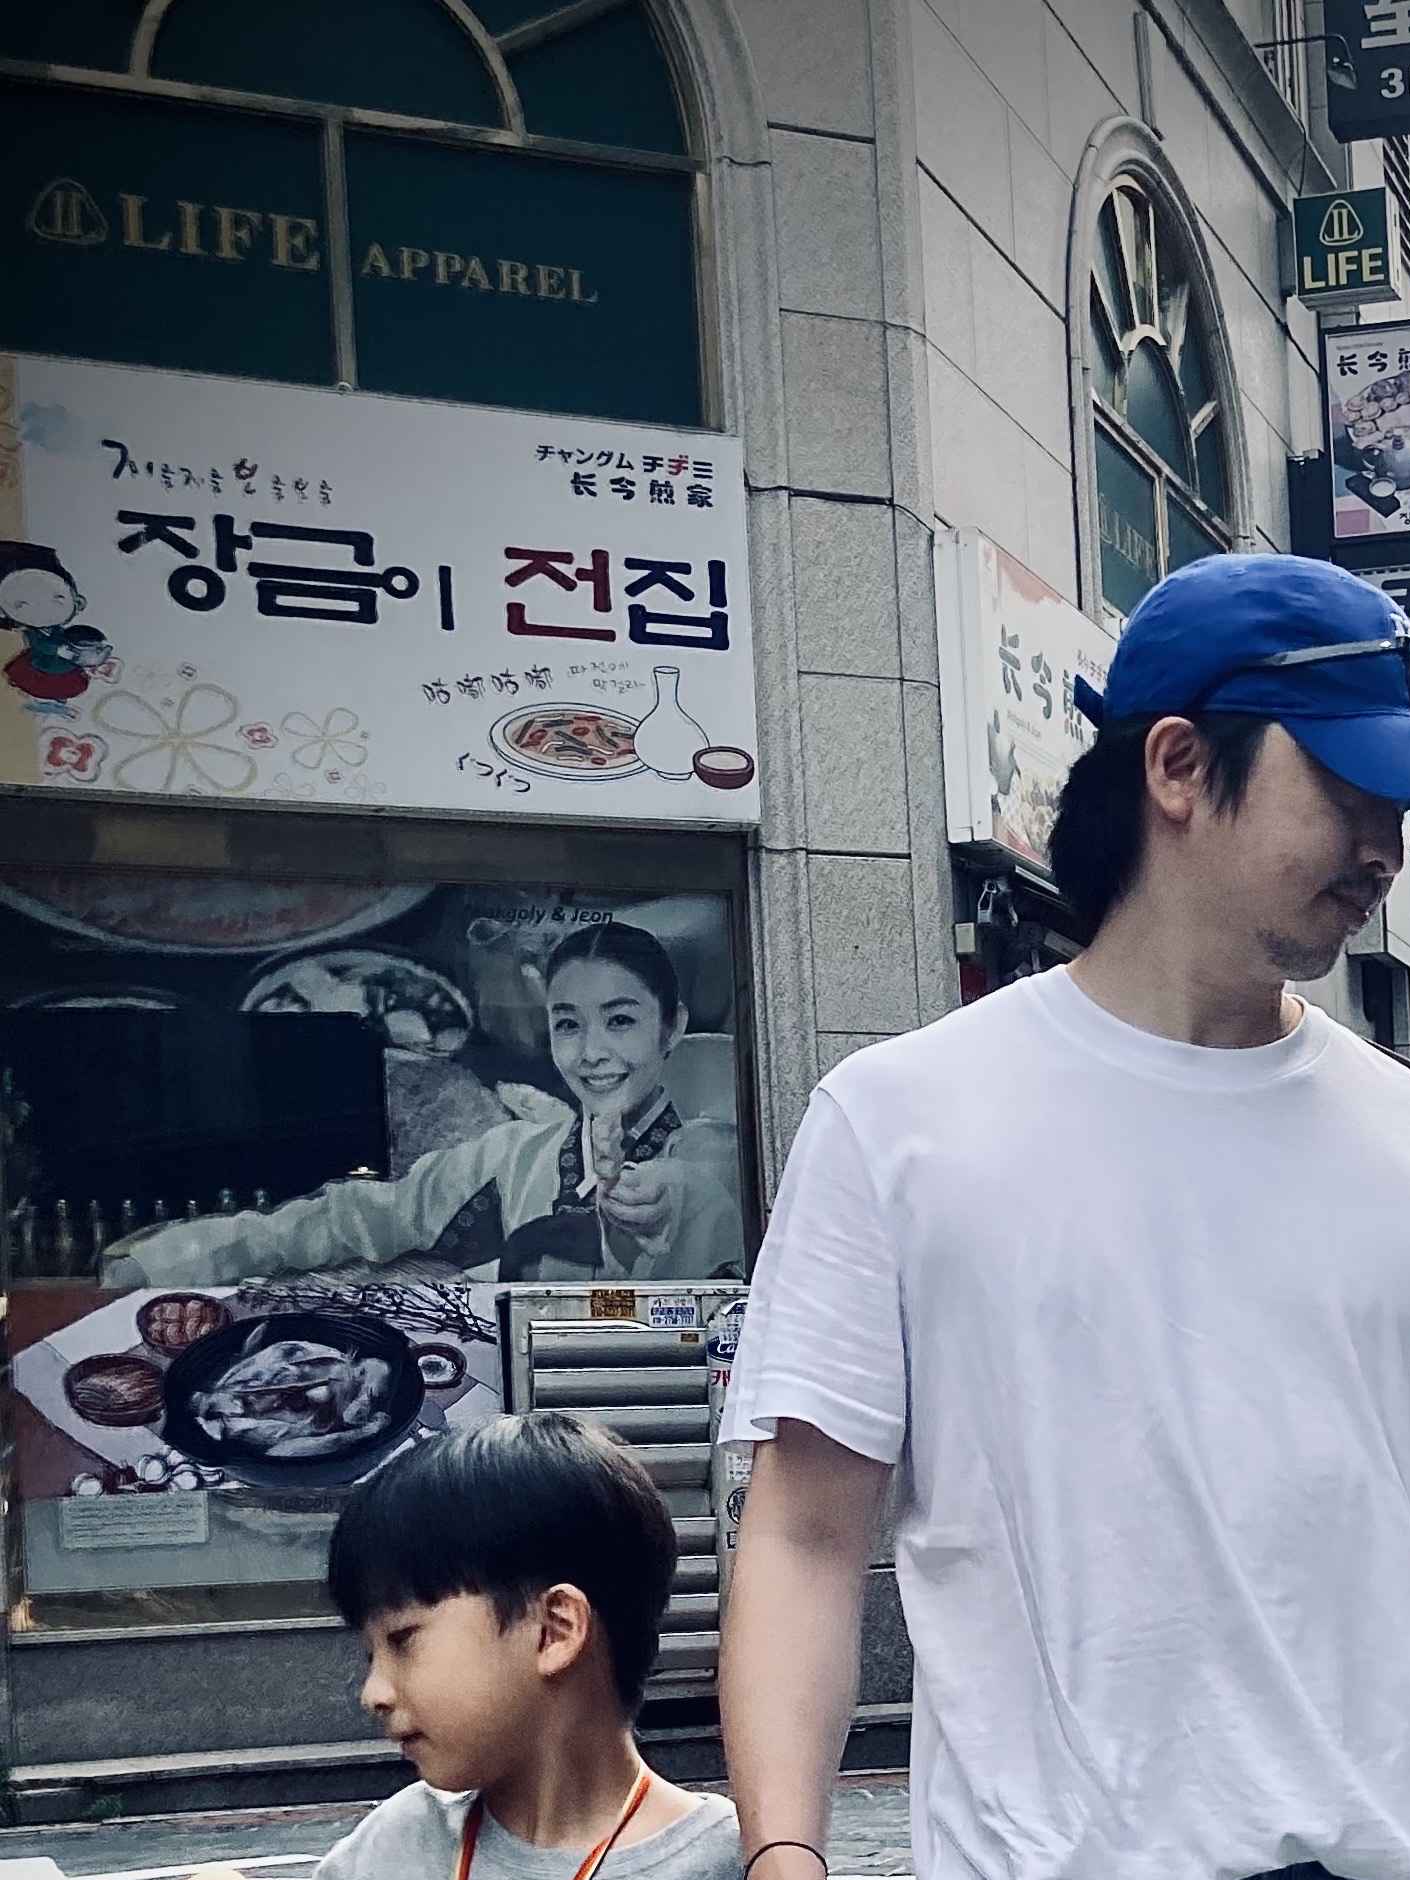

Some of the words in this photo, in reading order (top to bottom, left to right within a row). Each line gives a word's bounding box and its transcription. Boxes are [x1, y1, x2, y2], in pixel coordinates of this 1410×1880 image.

[119, 193, 321, 271] LIFE
[362, 243, 599, 304] APPAREL
[1303, 247, 1385, 290] LIFE
[536, 445, 635, 471] チャングム
[570, 472, 714, 508] 长今煎家
[117, 509, 456, 632] 장금이
[503, 546, 731, 651] 전집
[551, 906, 566, 921] &
[570, 907, 614, 924] Jeon
